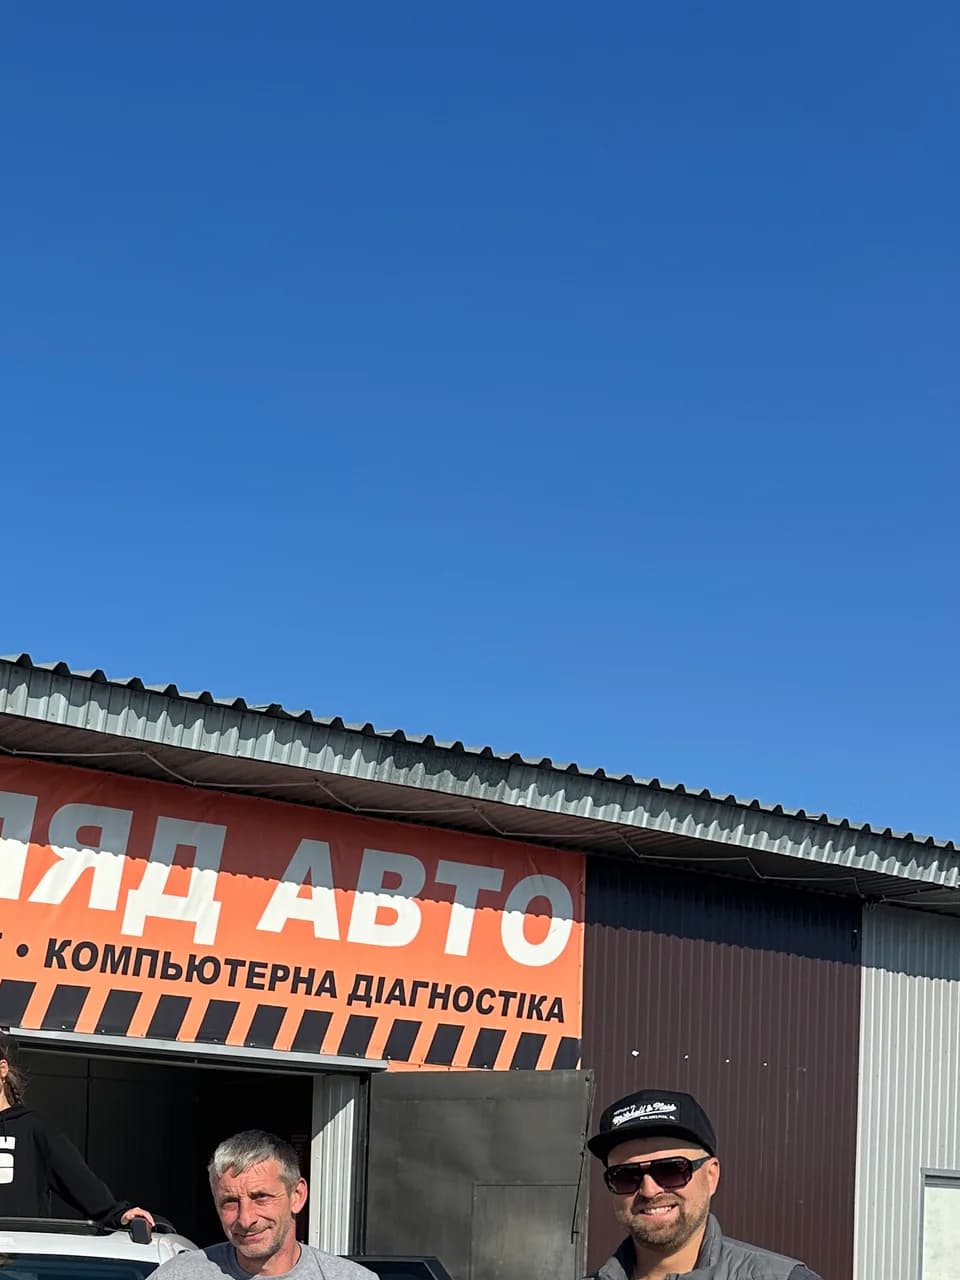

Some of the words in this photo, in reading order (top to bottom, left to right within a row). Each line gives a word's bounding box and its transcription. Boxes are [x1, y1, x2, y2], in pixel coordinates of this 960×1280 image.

[256, 838, 573, 967] АВТО
[44, 937, 337, 999] КОМПЬЮТЕРНА
[346, 974, 565, 1024] ДІАГНОСТІКА
